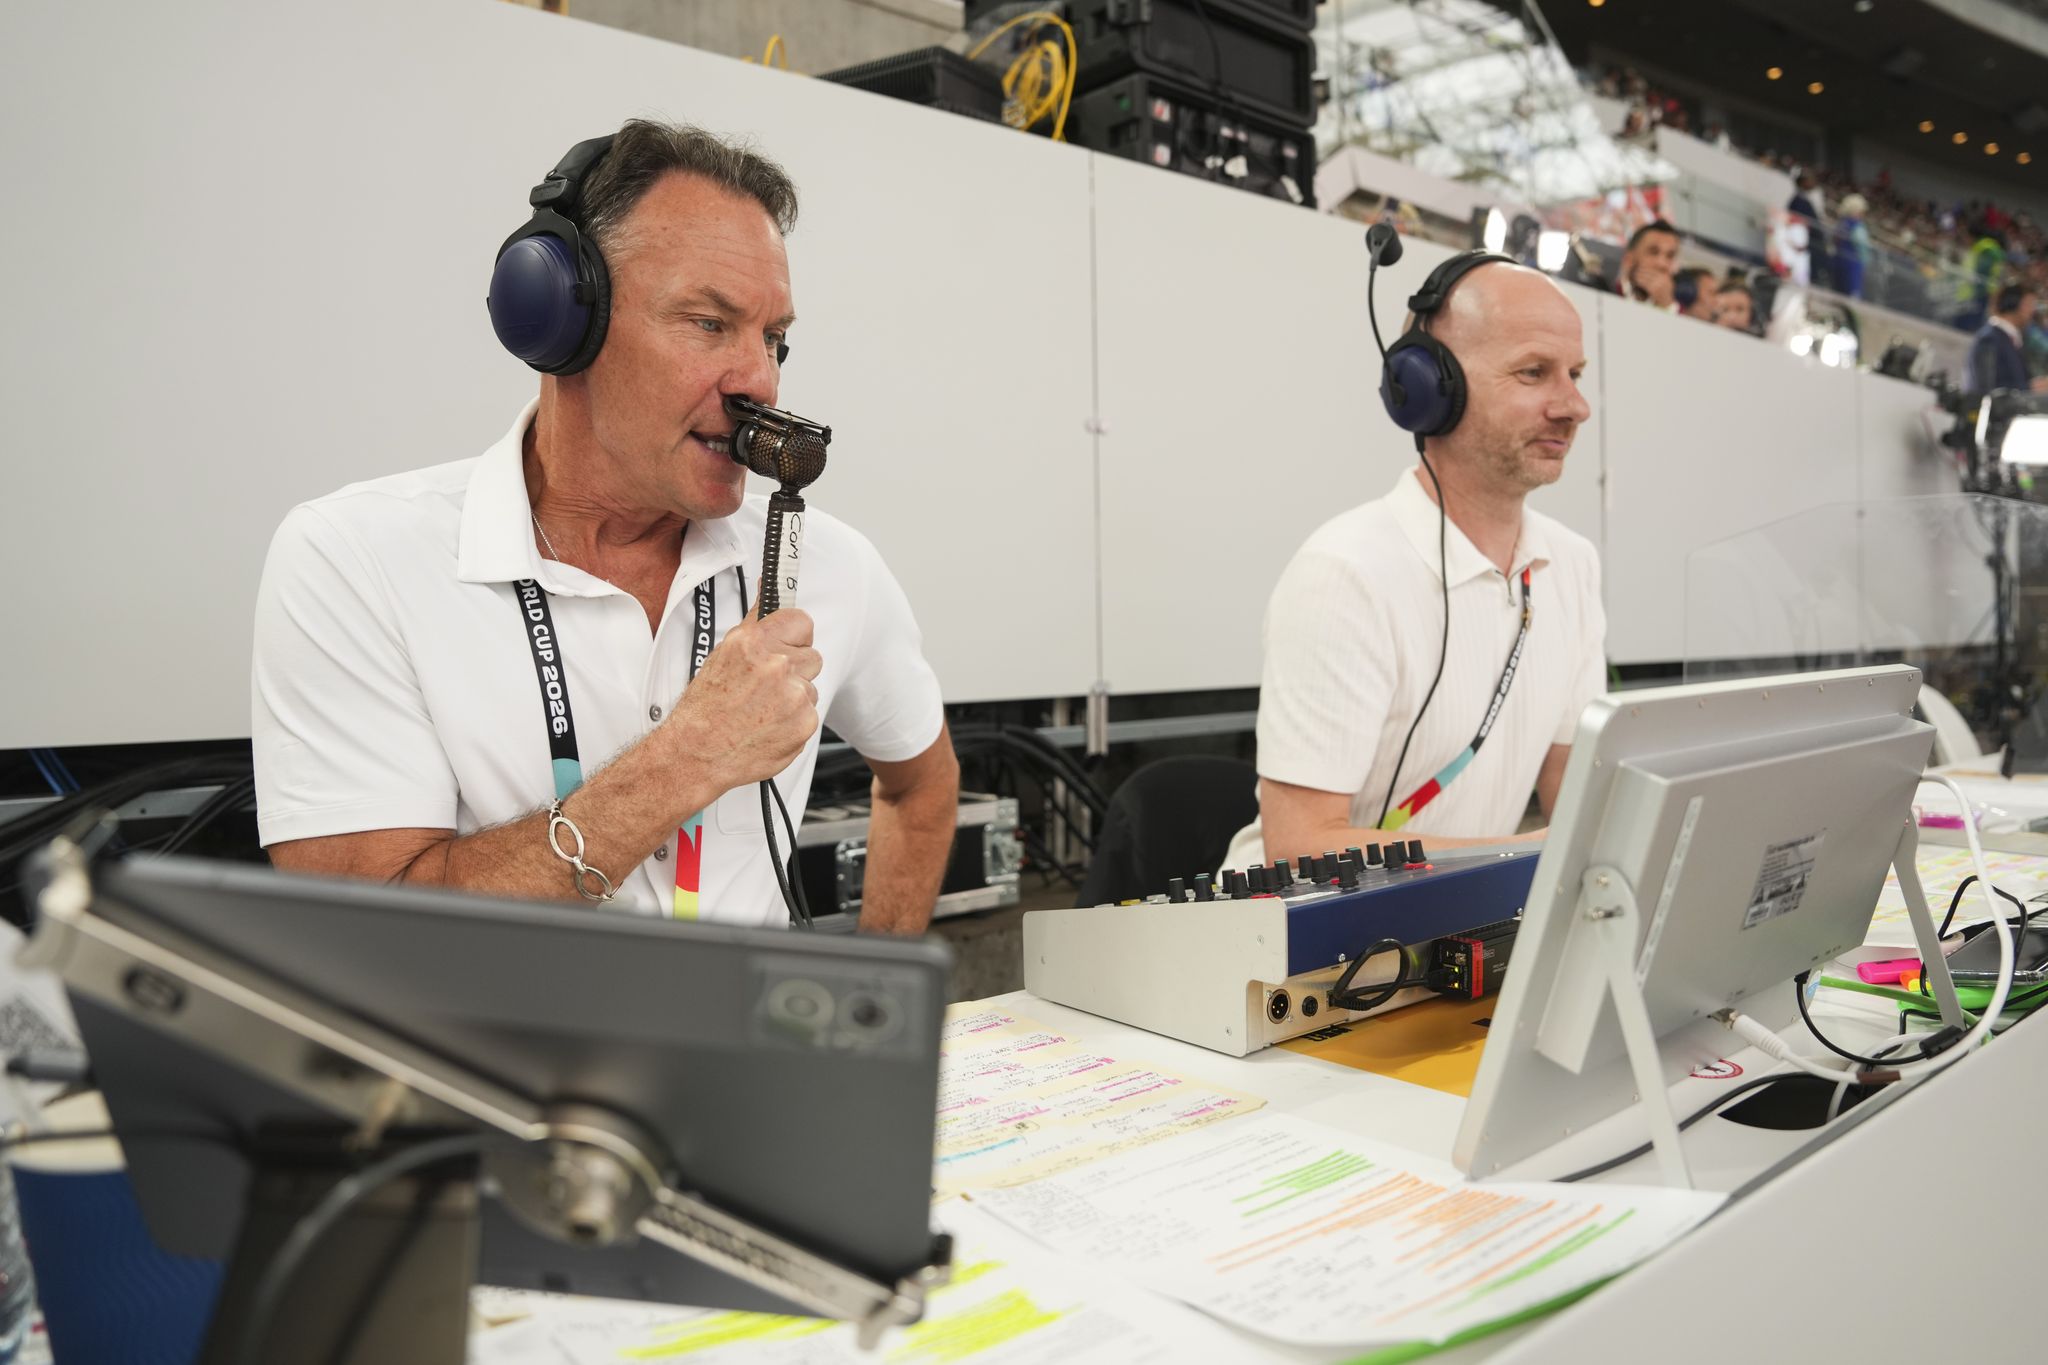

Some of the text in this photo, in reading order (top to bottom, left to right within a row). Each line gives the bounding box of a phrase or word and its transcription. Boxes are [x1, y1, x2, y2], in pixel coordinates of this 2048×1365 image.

[518, 579, 544, 622] ORLD
[699, 594, 711, 630] CUP
[533, 624, 554, 662] CUP
[542, 665, 569, 735] 2026
[1500, 667, 1514, 695] CUP
[1479, 692, 1502, 738] 2026
